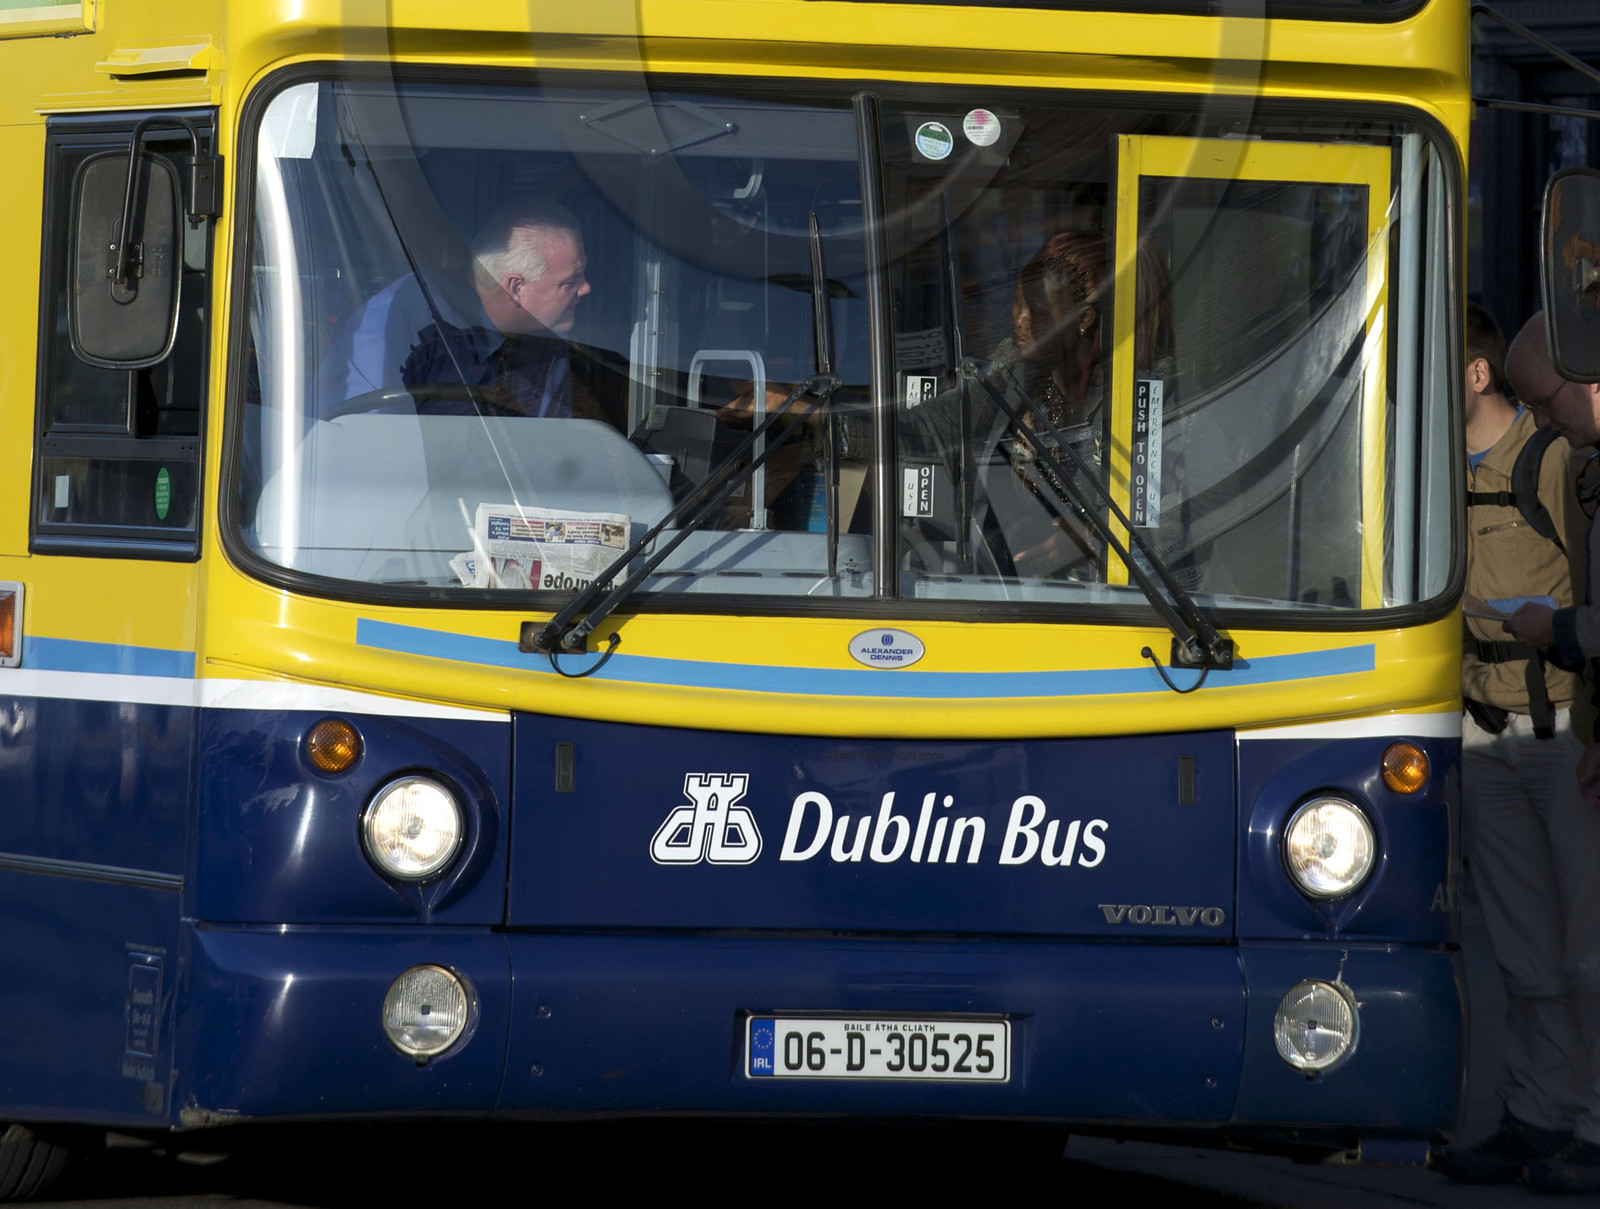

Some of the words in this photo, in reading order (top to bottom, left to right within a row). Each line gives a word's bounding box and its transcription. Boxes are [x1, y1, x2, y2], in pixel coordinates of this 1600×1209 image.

[1137, 385, 1147, 433] PUSH
[1150, 385, 1160, 480] EMERGENCY
[1136, 441, 1146, 465] TO
[1135, 474, 1145, 522] OPEN
[543, 572, 593, 592] urope
[860, 647, 914, 656] ALEXANDER
[869, 654, 904, 662] DENNIS
[780, 791, 987, 865] Dublin
[998, 794, 1109, 869] Bus
[1097, 903, 1226, 927] VOLVO
[844, 1023, 872, 1032] BAILE
[875, 1022, 900, 1032] ÁTHA
[902, 1024, 937, 1033] CLIATH
[753, 1057, 773, 1070] IRL
[784, 1030, 996, 1074] 06-D-30525
